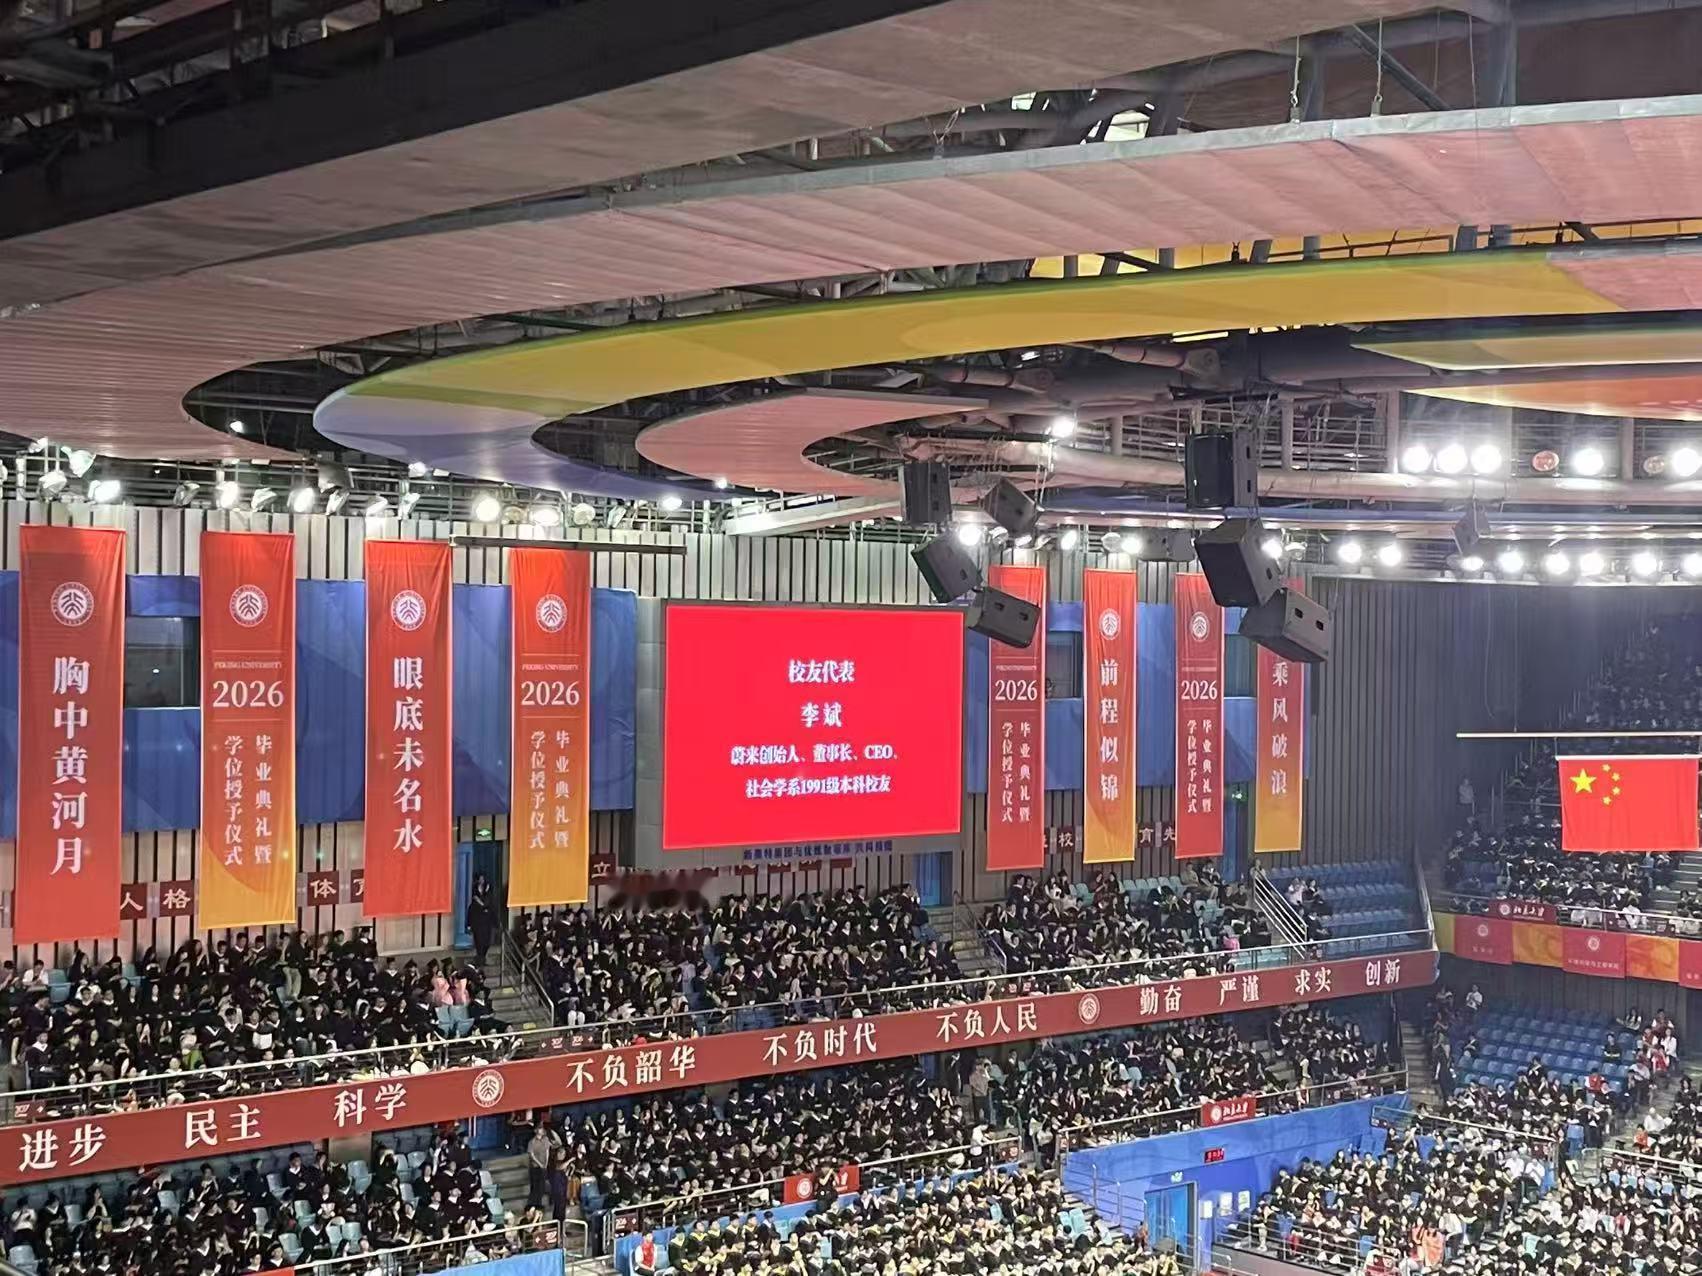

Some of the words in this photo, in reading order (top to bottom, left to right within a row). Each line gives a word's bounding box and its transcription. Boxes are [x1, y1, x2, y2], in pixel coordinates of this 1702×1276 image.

[212, 680, 284, 708] 2026
[521, 680, 580, 706] 2026
[788, 659, 855, 683] 校友代表
[801, 702, 842, 727] 李斌
[995, 679, 1038, 701] 2026
[1181, 680, 1218, 700] 2026
[51, 656, 90, 875] 胸中黄河月
[392, 656, 424, 853] 眼底未名水
[1001, 722, 1013, 823] 学位授予仪式
[1019, 721, 1031, 822] 毕业典礼暨
[1100, 659, 1119, 801] 前程似锦
[1187, 719, 1197, 813] 学位授予仪式
[1202, 719, 1212, 813] 毕业典礼暨
[1271, 662, 1289, 795] 乘风破浪
[224, 735, 243, 866] 学位授予仪式
[254, 734, 273, 864] 毕业典礼暨
[529, 730, 546, 849] 学位授予仪式
[554, 730, 571, 848] 毕业典礼暨
[745, 774, 891, 798] 社会学系1991级本科校友
[120, 888, 191, 912] 人格
[591, 861, 611, 879] 立
[19, 1123, 106, 1173] 进步
[184, 1103, 261, 1150] 民主
[333, 1083, 407, 1128] 科学
[566, 1044, 696, 1093] 不负韶华
[762, 1021, 877, 1066] 不负时代
[935, 1002, 1038, 1043] 不负人民
[1139, 984, 1182, 1016] 勤奋
[1218, 974, 1261, 1006] 严谨
[1295, 966, 1332, 996] 求实
[1365, 958, 1401, 987] 创新
